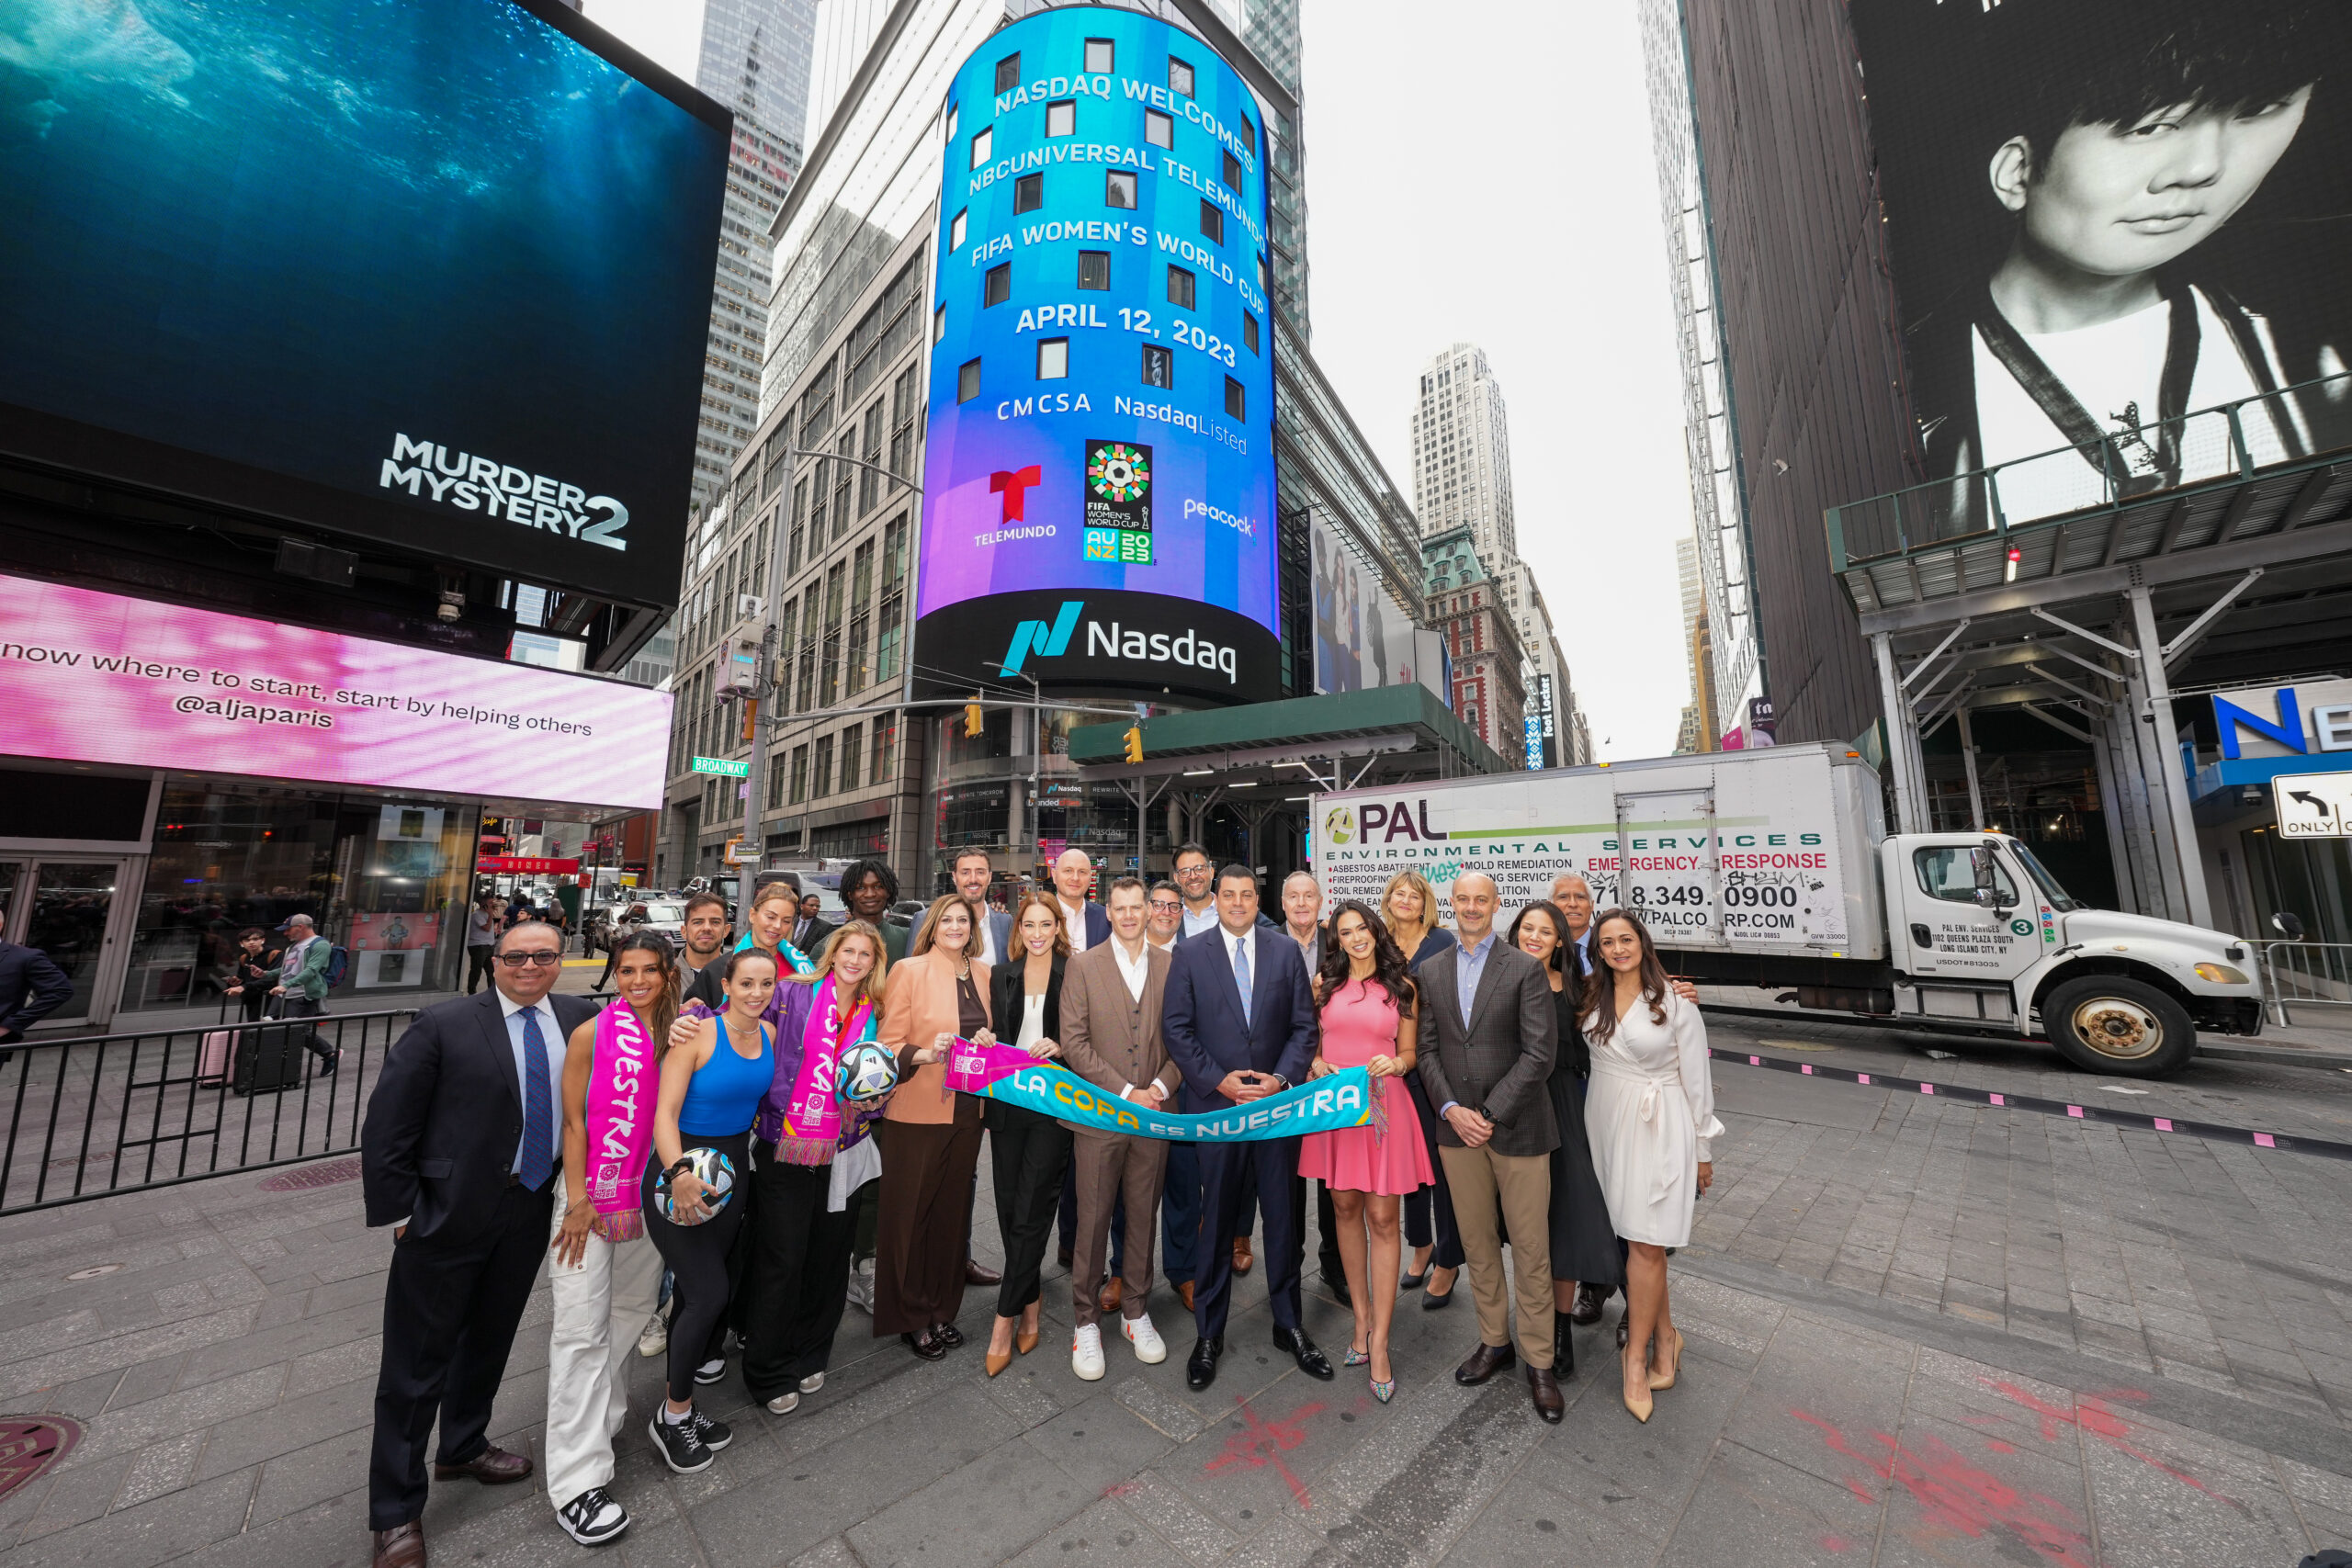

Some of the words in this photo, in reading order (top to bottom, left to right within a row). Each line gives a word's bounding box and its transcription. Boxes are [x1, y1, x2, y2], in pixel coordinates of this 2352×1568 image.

[994, 74, 1112, 118] NASDAQ
[1121, 77, 1255, 174] WELCOMES
[969, 144, 1155, 196] NBCUNIVERSAL
[1162, 156, 1267, 254] TELEMUNDO
[972, 233, 1013, 267] FIFA
[1022, 220, 1148, 247] WOMEN'S
[1157, 231, 1234, 286] WORLD
[1238, 277, 1264, 316] CUP
[1015, 304, 1107, 333] APRIL
[1118, 308, 1160, 339] 12,
[1173, 320, 1236, 368] 2023
[997, 393, 1091, 421] CMCSA
[392, 432, 587, 514] MURDER
[379, 458, 591, 538] MYSTERY
[581, 495, 629, 552] 2
[1087, 502, 1110, 511] FIFA
[1087, 510, 1131, 520] WOMEN'S
[1087, 517, 1120, 527] WORLD
[1121, 520, 1139, 528] CUP
[1184, 499, 1252, 537] peacock
[974, 525, 1057, 547] TELEMUNDO
[1087, 530, 1115, 545] AU
[1087, 545, 1115, 558] NZ
[1088, 621, 1236, 684] Nasdaq
[1, 643, 82, 666] now
[92, 656, 200, 682] where
[210, 670, 241, 688] to
[249, 677, 327, 703] start,
[335, 690, 400, 710] start
[407, 696, 435, 717] by
[441, 701, 520, 730] helping
[526, 716, 593, 737] others
[175, 695, 333, 728] @aljaparis
[1543, 714, 1554, 737] Foot
[695, 758, 747, 776] BROADWAY
[1058, 785, 1082, 794] Nasdaq
[1360, 798, 1447, 845] PAL
[2288, 821, 2335, 833] ONLY
[1089, 828, 1122, 838] Nasdaq
[1326, 841, 1571, 861] ENVIRONMENTAL
[1602, 832, 1822, 851] SERVICES
[1333, 863, 1375, 873] ASBESTOS
[1378, 863, 1430, 873] ABATEMENT
[1464, 861, 1495, 870] MOLD
[1498, 859, 1572, 870] REMEDIATION
[1589, 856, 1699, 871] EMERGENCY
[1722, 853, 1827, 869] RESPONSE
[1352, 886, 1385, 895] REMEDI
[1497, 886, 1531, 895] LITION
[1942, 924, 1954, 932] PAL
[1955, 924, 1969, 933] ENV.
[1970, 924, 2000, 933] SERVICES
[2016, 921, 2030, 934] 3
[1932, 933, 1945, 942] 1102
[1946, 935, 1970, 943] QUEENS
[1972, 935, 1992, 943] PLAZA
[1993, 936, 2014, 944] SOUTH
[1939, 944, 1955, 953] LONG
[1957, 945, 1979, 953] ISLAND
[1981, 945, 1997, 954] CITY,
[1999, 946, 2007, 954] NY
[1936, 959, 2000, 968] USDOT#813035
[601, 1010, 643, 1160] NUESTRA
[1013, 1068, 1046, 1098] LA
[1054, 1081, 1140, 1130] COPA
[1148, 1121, 1186, 1137] ES
[1196, 1084, 1361, 1138] NUESTRA
